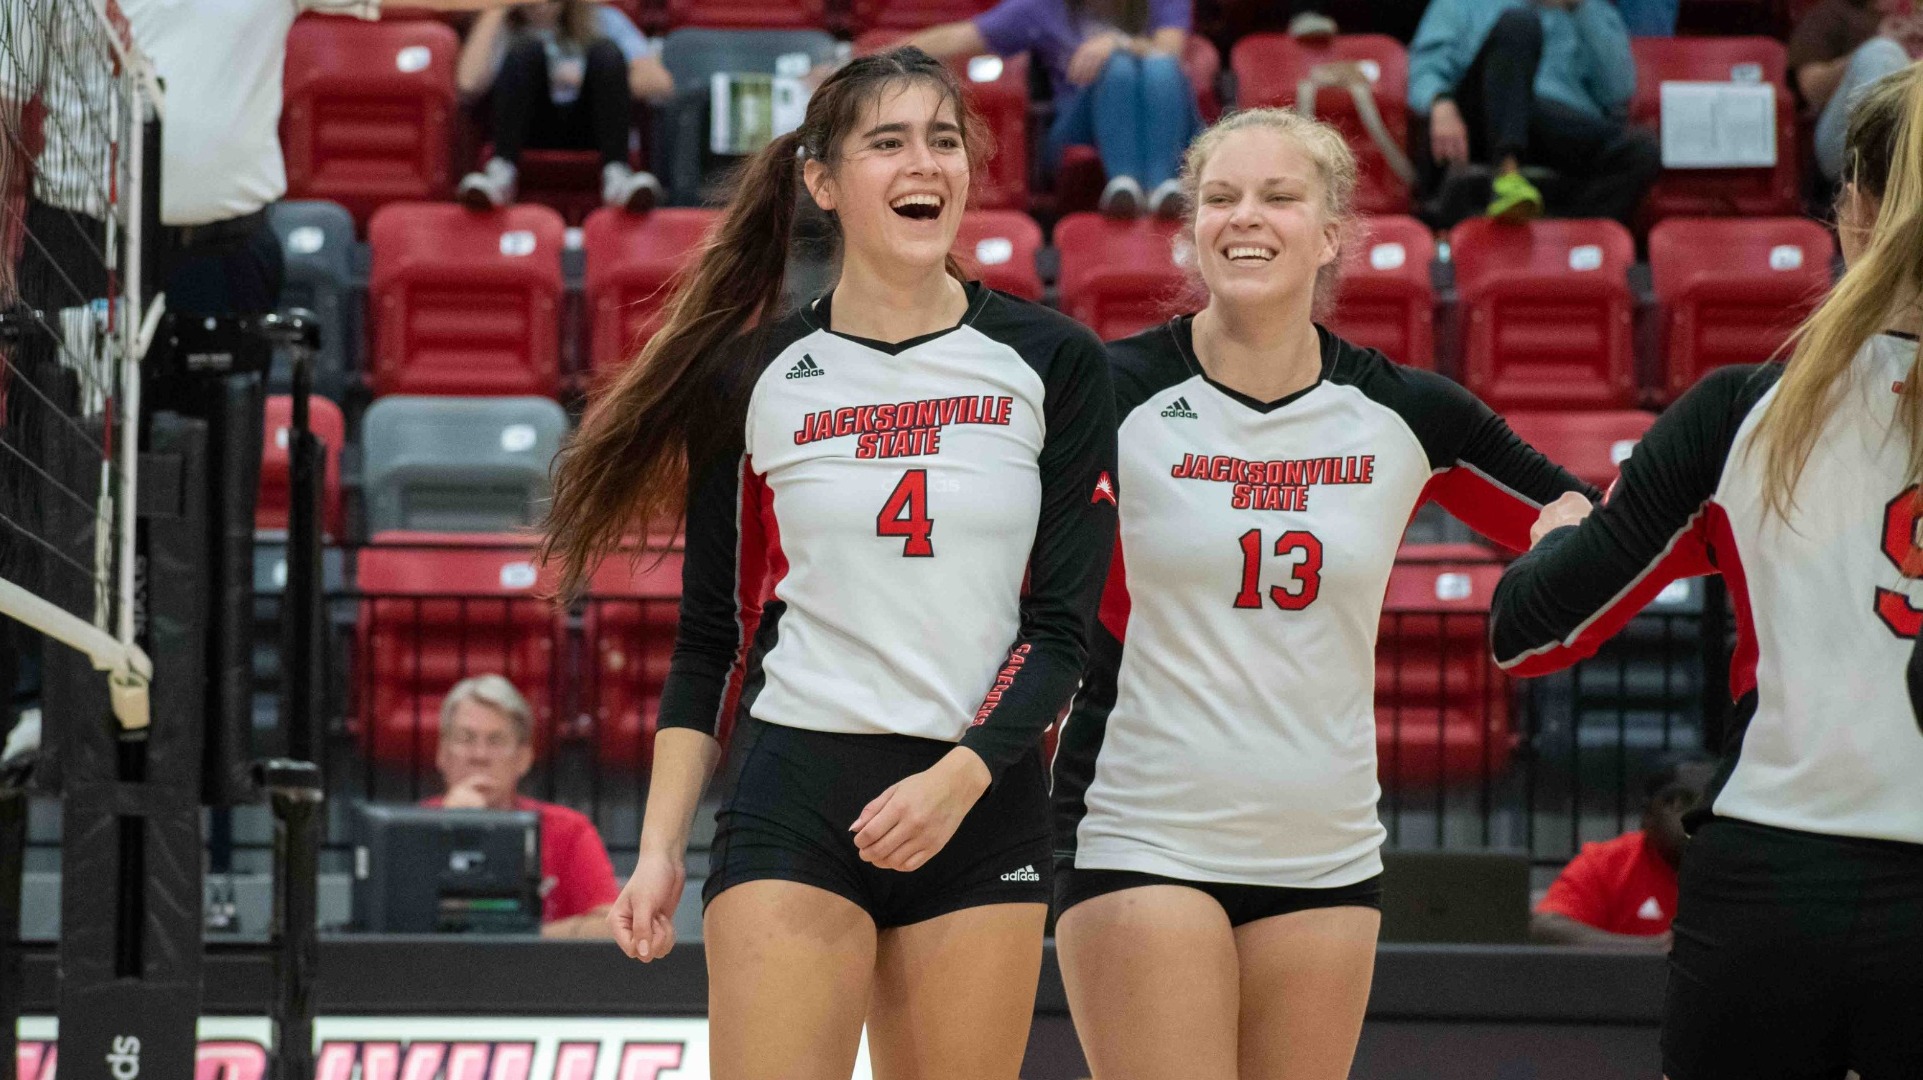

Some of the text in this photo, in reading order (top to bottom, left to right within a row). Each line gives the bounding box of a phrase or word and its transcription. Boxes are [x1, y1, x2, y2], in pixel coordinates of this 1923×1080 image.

[785, 368, 825, 379] adidas
[794, 395, 1013, 445] JACKSONVILLE
[1161, 408, 1198, 419] adidas
[855, 427, 942, 459] STATE
[1171, 453, 1375, 485] JACKSONVILLE
[876, 468, 935, 558] 4
[1231, 483, 1309, 511] STATE
[1233, 528, 1323, 611] 13
[1000, 869, 1040, 882] adidas
